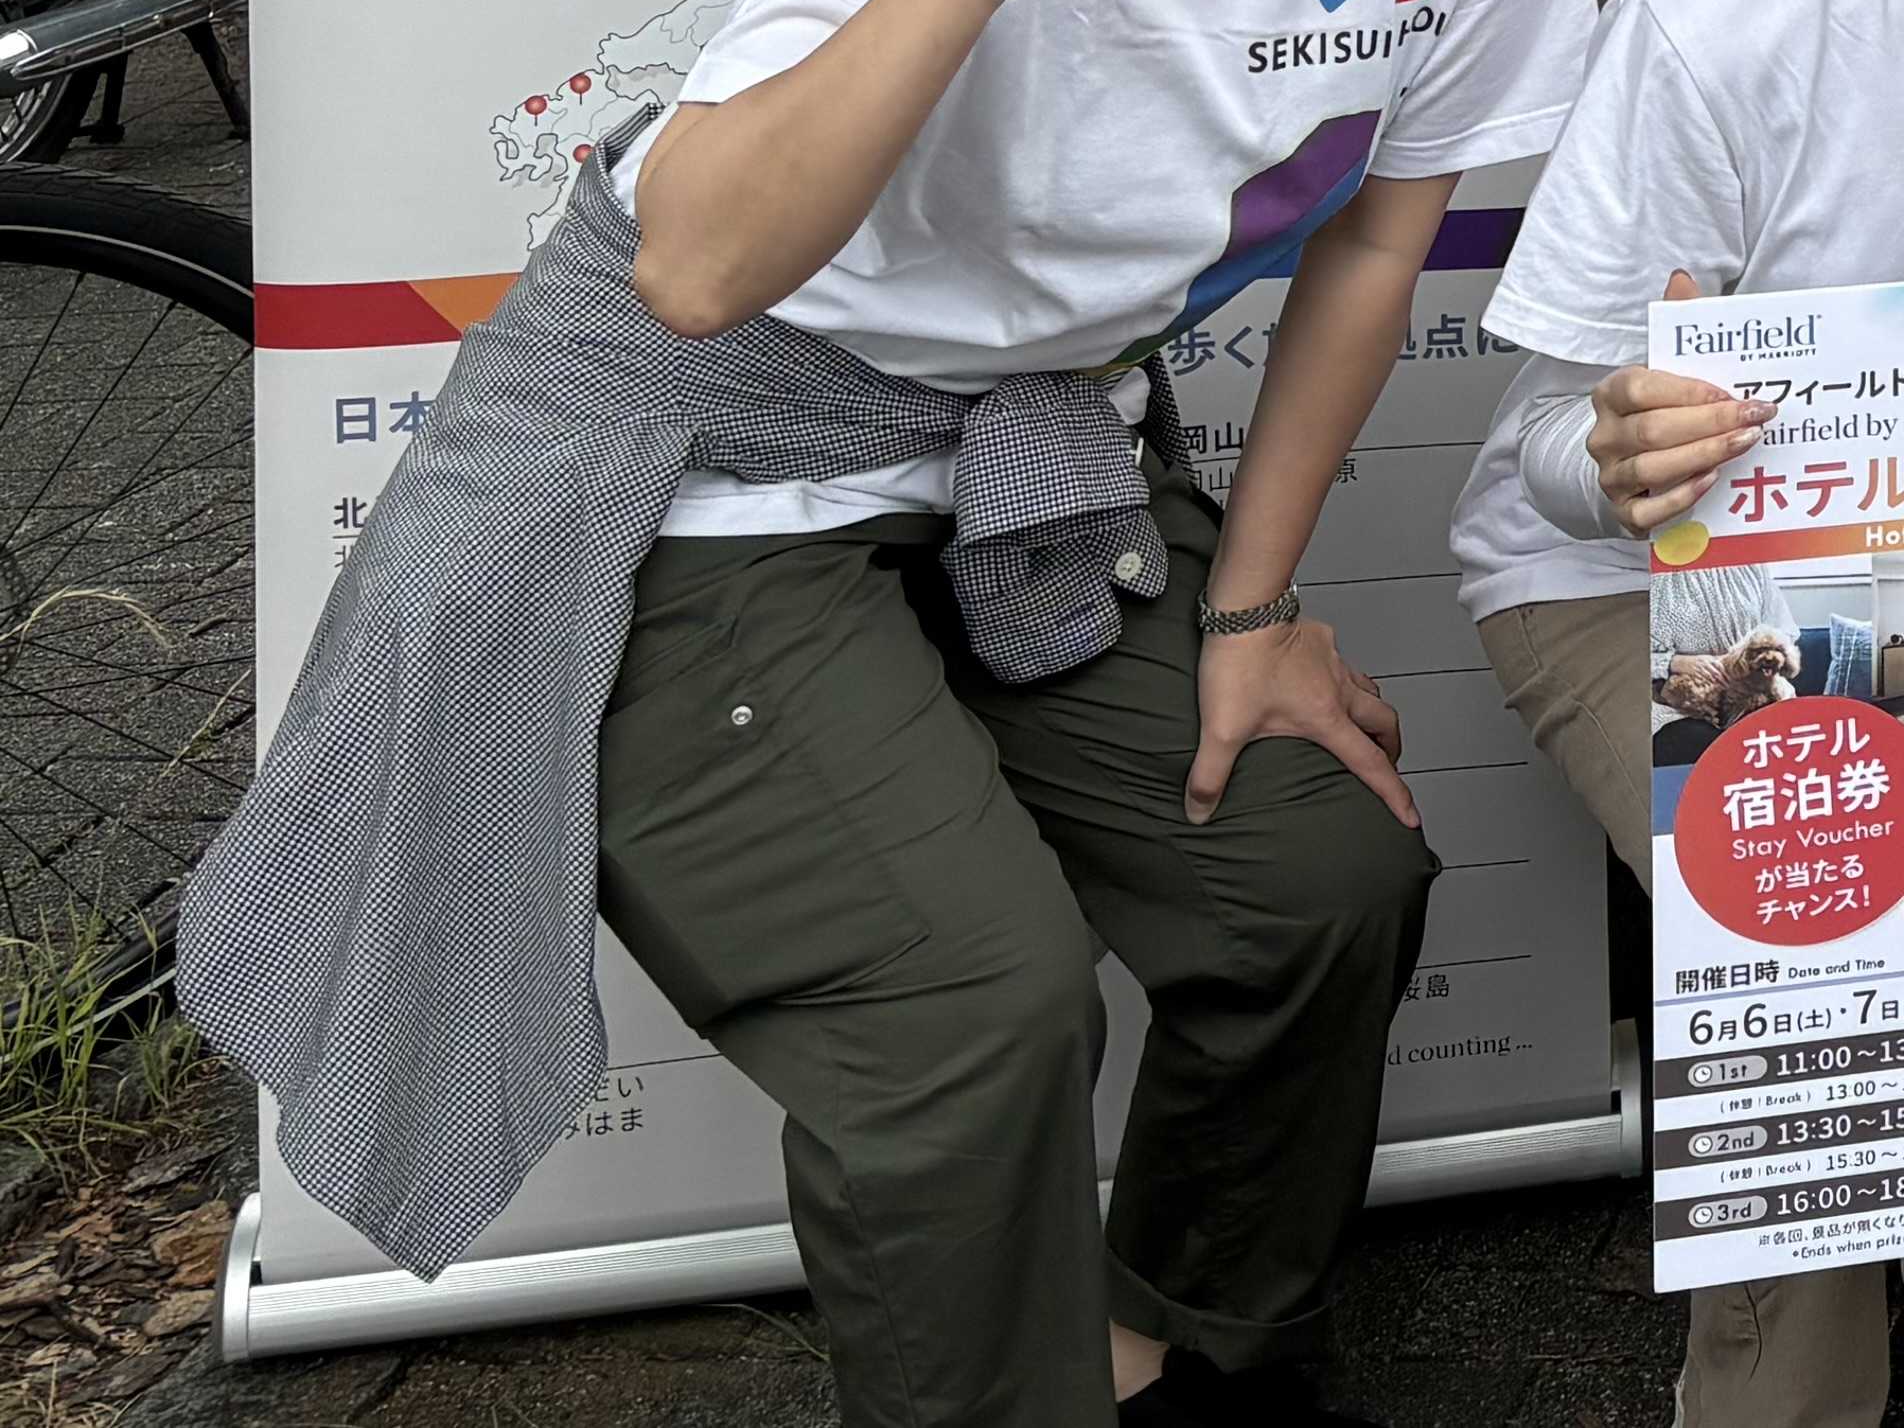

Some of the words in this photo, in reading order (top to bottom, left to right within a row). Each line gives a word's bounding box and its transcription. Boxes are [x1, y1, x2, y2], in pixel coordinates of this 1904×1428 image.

[1248, 29, 1393, 73] SEKISUI
[1723, 758, 1889, 832] 宿泊券
[1796, 821, 1893, 848] Voucher
